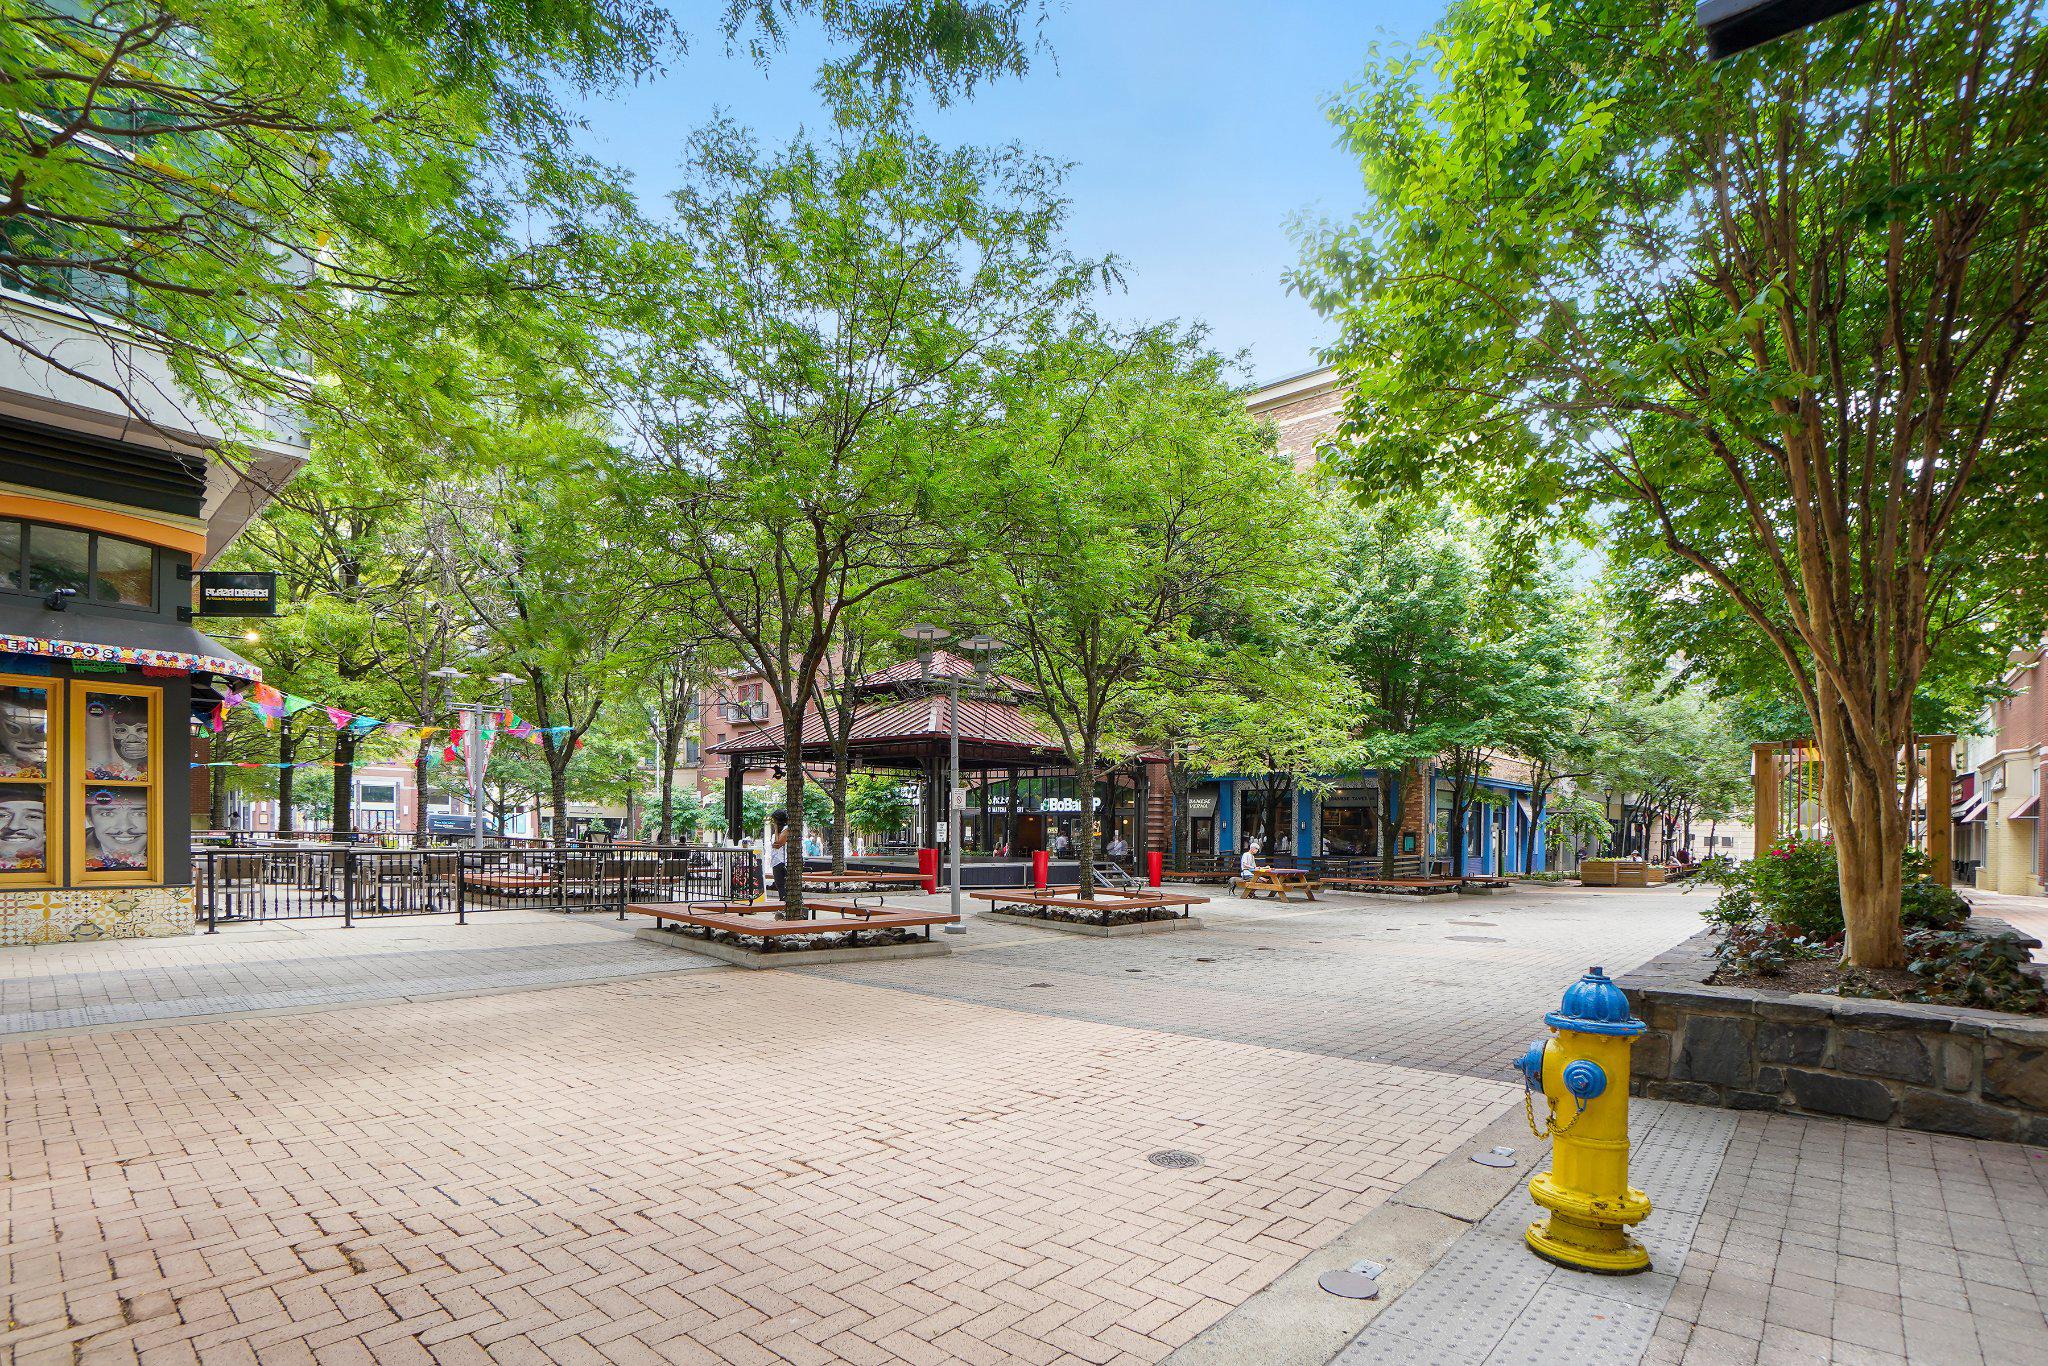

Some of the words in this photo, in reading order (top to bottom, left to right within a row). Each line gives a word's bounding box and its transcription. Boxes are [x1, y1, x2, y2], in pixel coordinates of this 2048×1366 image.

[205, 588, 234, 597] PLAZA
[8, 640, 115, 659] ENIDOS
[1050, 797, 1102, 812] BoBaP
